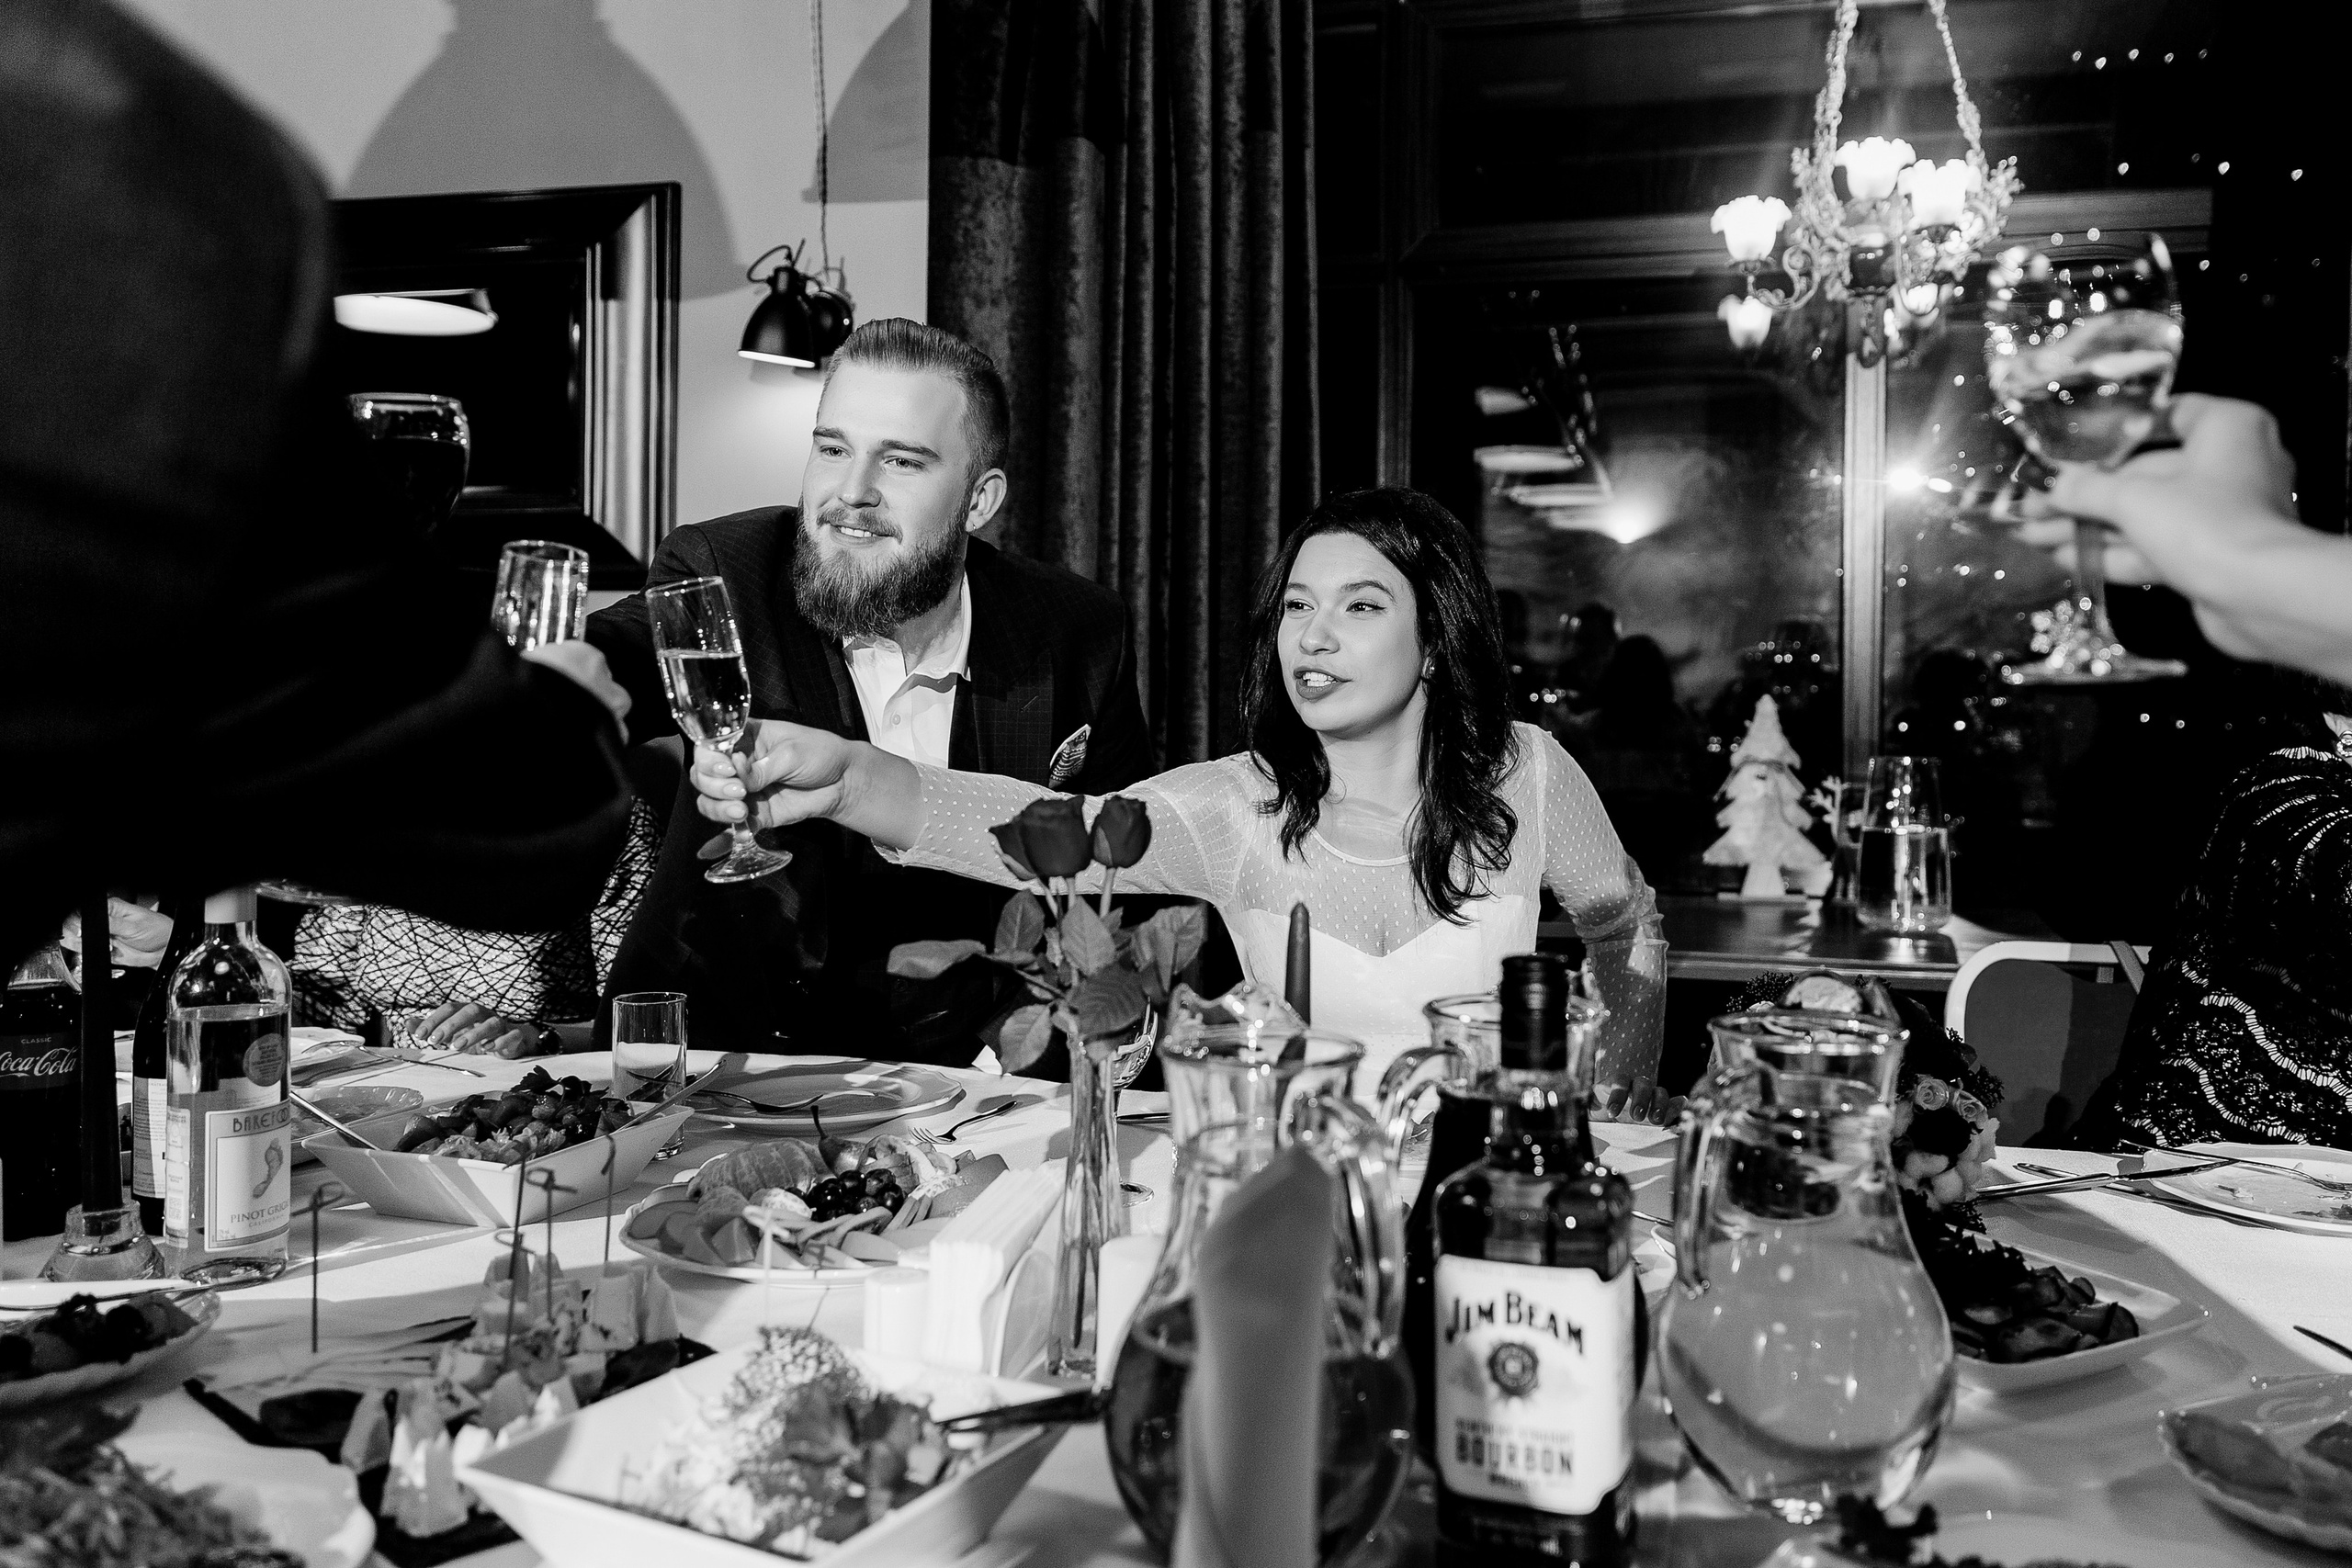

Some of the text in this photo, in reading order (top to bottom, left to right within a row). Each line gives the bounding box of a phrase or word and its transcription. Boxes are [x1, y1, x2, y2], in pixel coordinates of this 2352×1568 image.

[20, 1036, 52, 1044] CLASSIC
[0, 1046, 77, 1077] Coca-Cola
[232, 1106, 290, 1133] BAREFOO
[231, 1200, 289, 1224] PINOT GRIG
[1445, 1290, 1583, 1355] JIM BEAM
[1455, 1431, 1574, 1475] BOURBON
